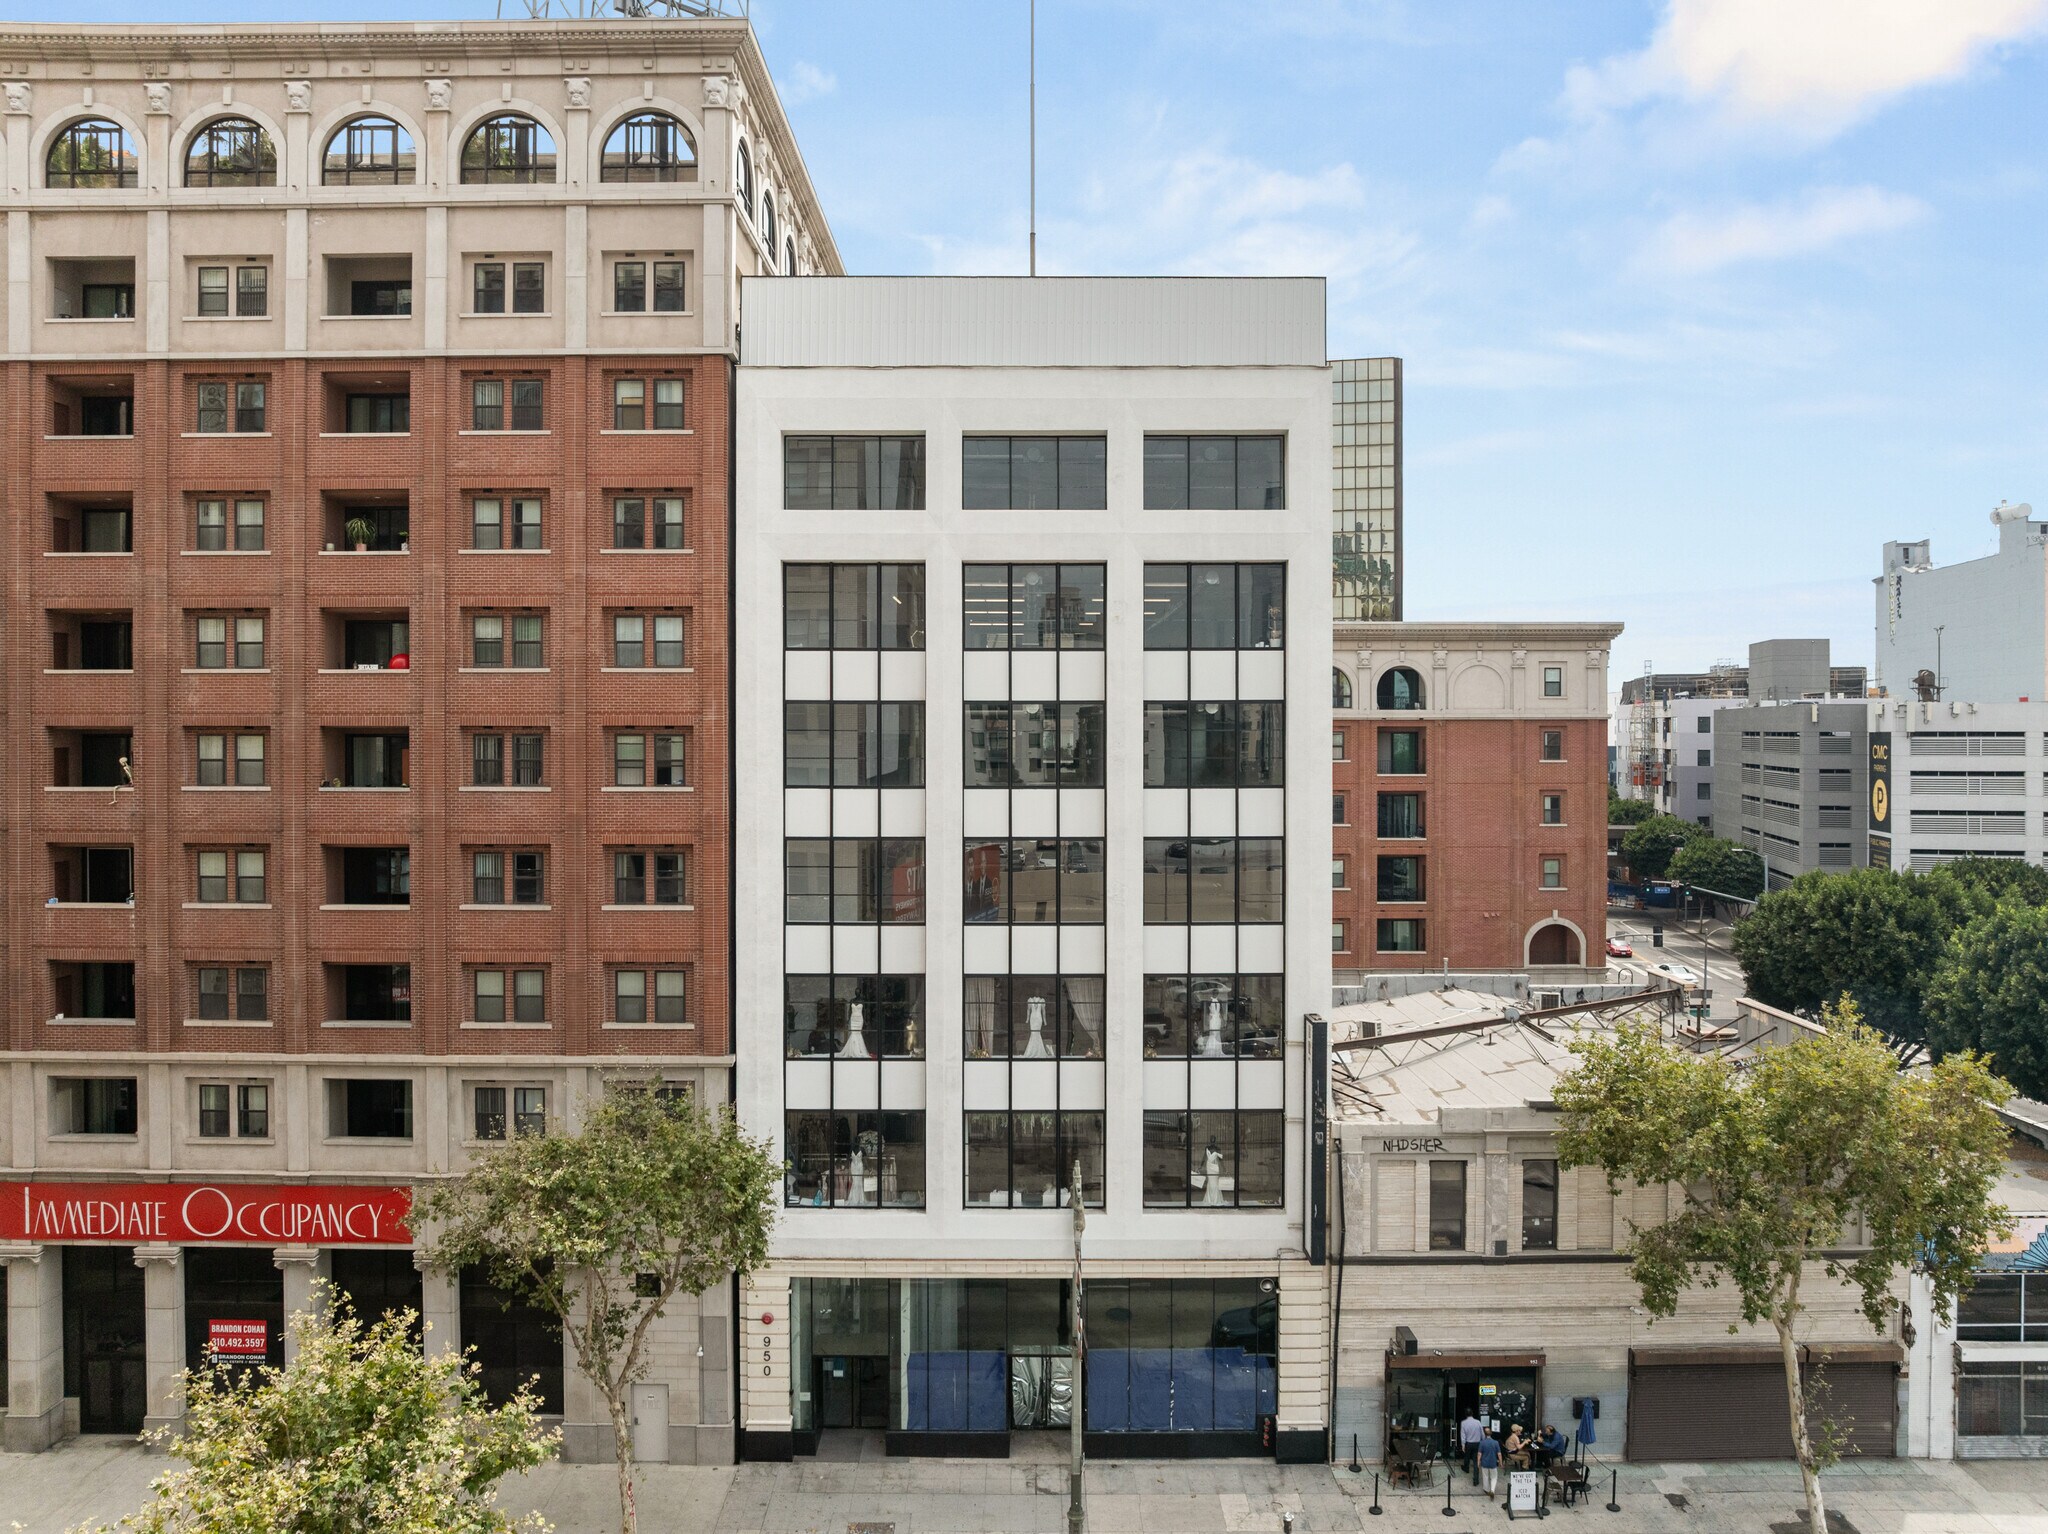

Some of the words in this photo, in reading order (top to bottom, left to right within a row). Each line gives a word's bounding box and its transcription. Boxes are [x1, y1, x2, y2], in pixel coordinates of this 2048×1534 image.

[1872, 745, 1888, 760] CMC
[1877, 786, 1884, 812] P
[24, 1186, 167, 1236] IMMEDIATE
[181, 1187, 384, 1238] OCCUPANCY
[211, 1325, 242, 1333] BRANDON
[243, 1325, 265, 1333] COHAN
[211, 1337, 265, 1347] 310.492.3597
[763, 1336, 771, 1376] 950
